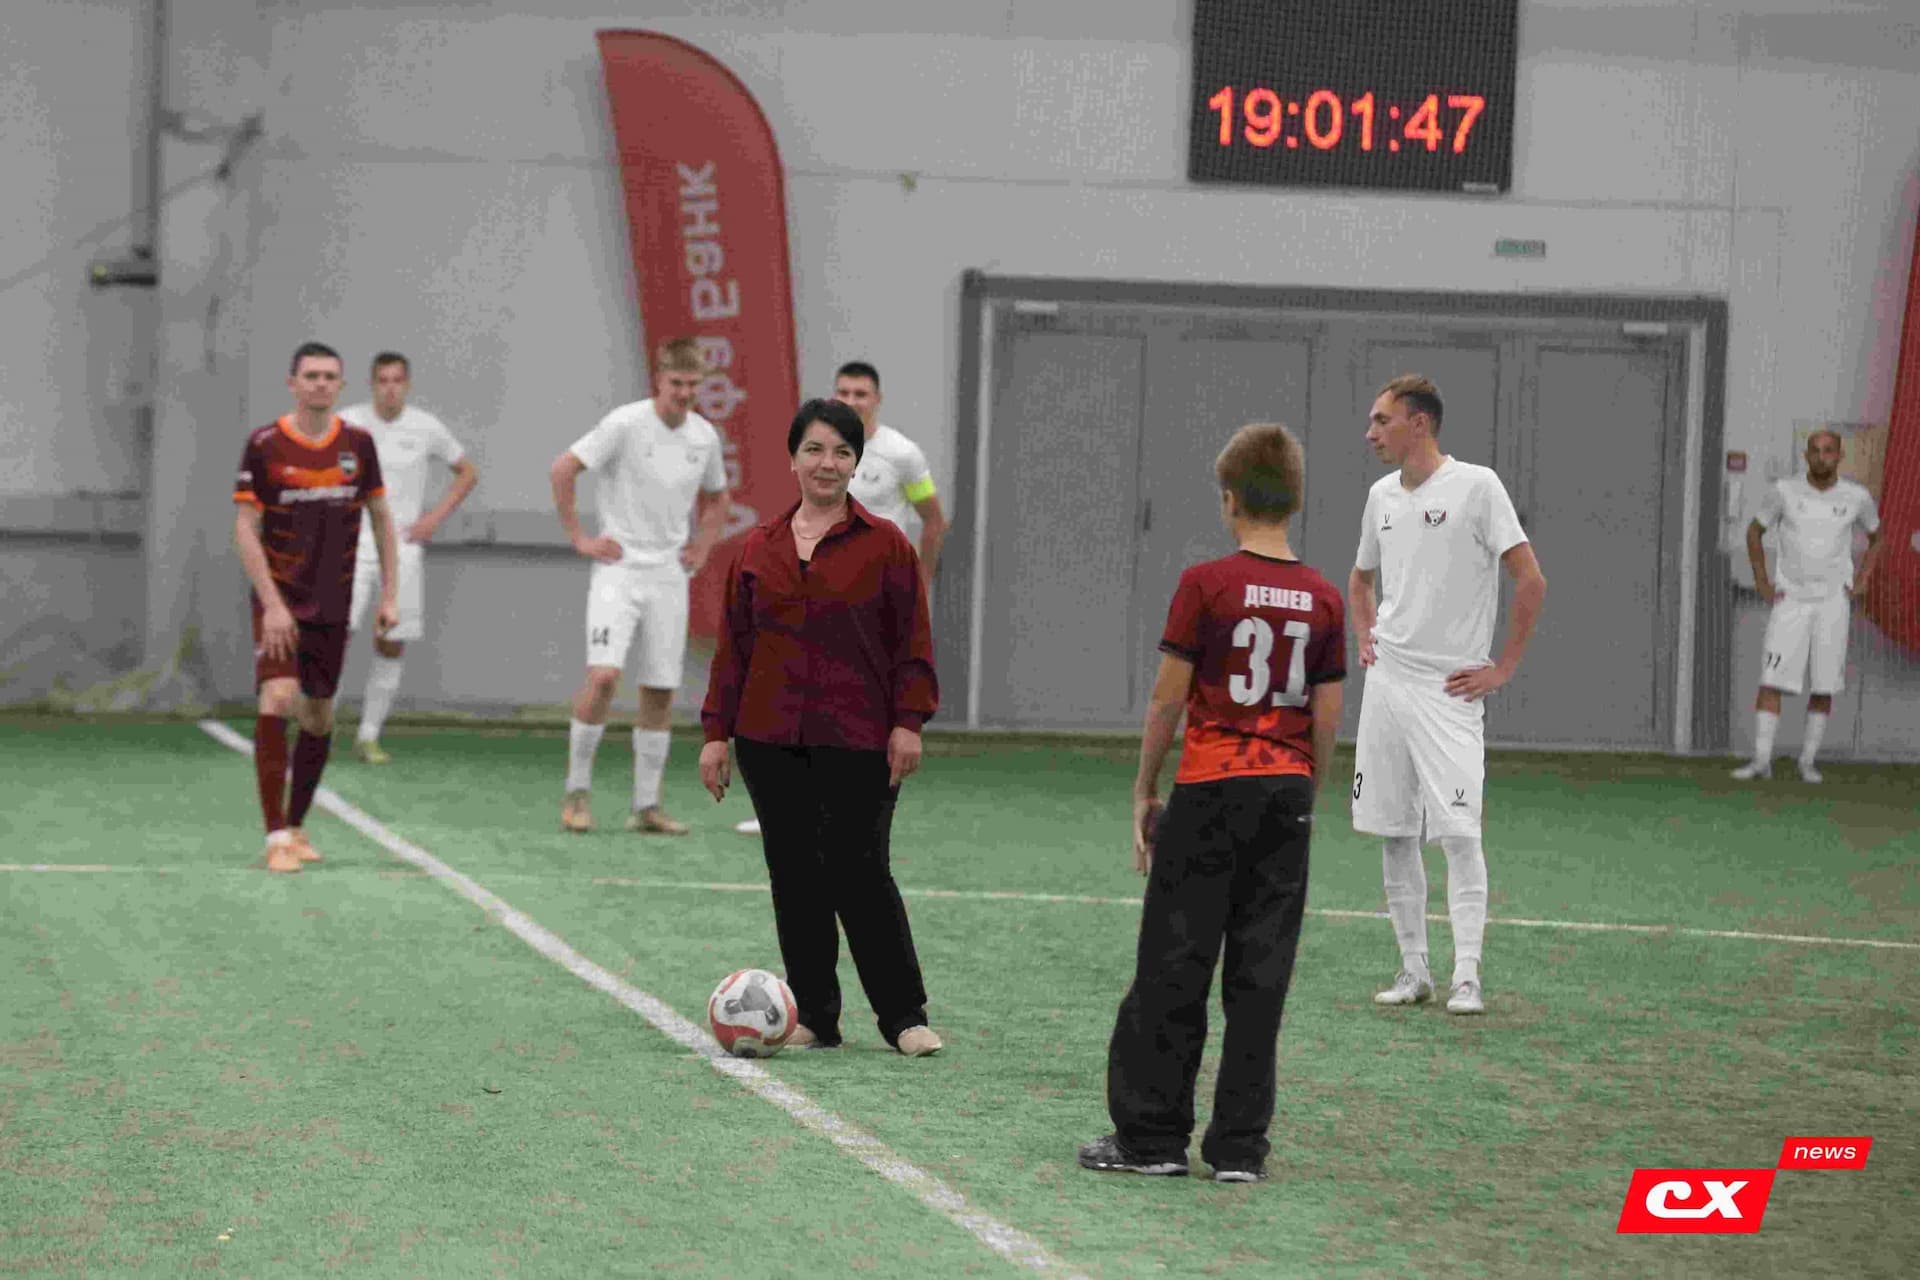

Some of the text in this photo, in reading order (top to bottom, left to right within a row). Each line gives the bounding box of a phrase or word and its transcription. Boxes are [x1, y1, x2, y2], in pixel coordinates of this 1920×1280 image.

[1208, 86, 1486, 154] 19:01:47
[1244, 584, 1313, 612] ДЕШЕВ
[1228, 616, 1311, 707] 31
